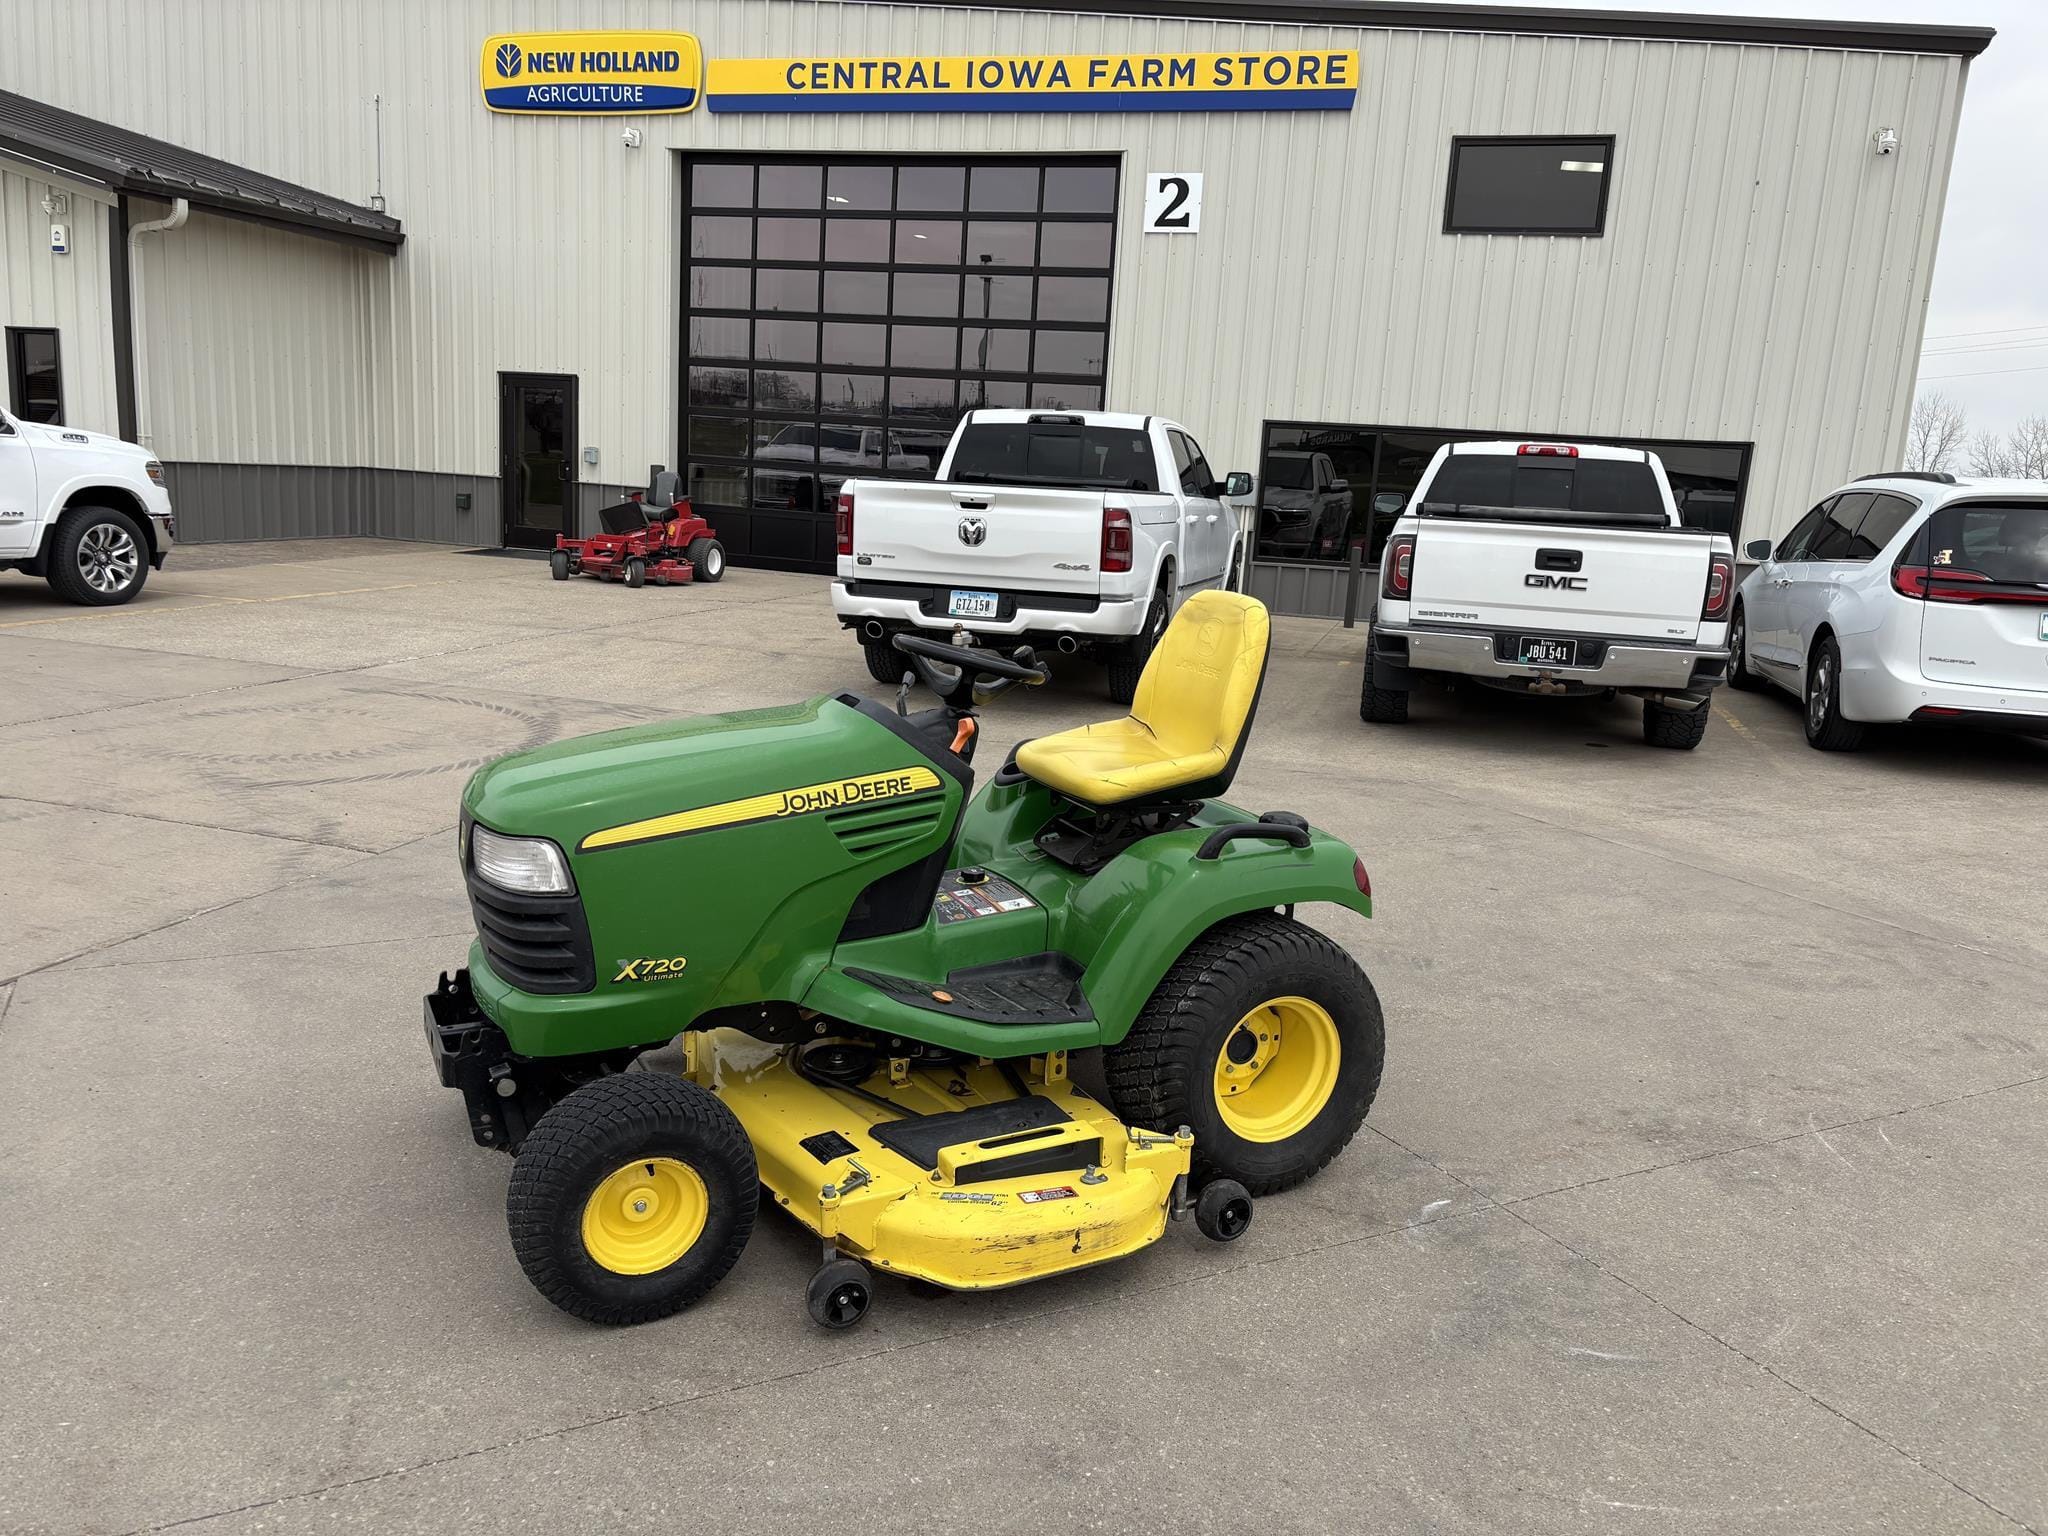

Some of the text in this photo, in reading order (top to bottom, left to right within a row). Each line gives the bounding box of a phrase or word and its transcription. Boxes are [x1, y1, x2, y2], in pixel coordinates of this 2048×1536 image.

[527, 50, 680, 73] NEW HOLLAND
[786, 54, 1348, 89] CENTRAL IOWA FARM STORE
[527, 84, 644, 103] AGRICULTURE
[1154, 177, 1190, 228] 2
[1525, 574, 1588, 591] GMC
[956, 598, 972, 611] GTZ
[1417, 610, 1479, 620] SIERRA
[1526, 645, 1567, 660] JBU 541
[777, 776, 913, 814] JOHN DEERE
[611, 956, 687, 982] X720
[643, 971, 684, 982] Ultimate
